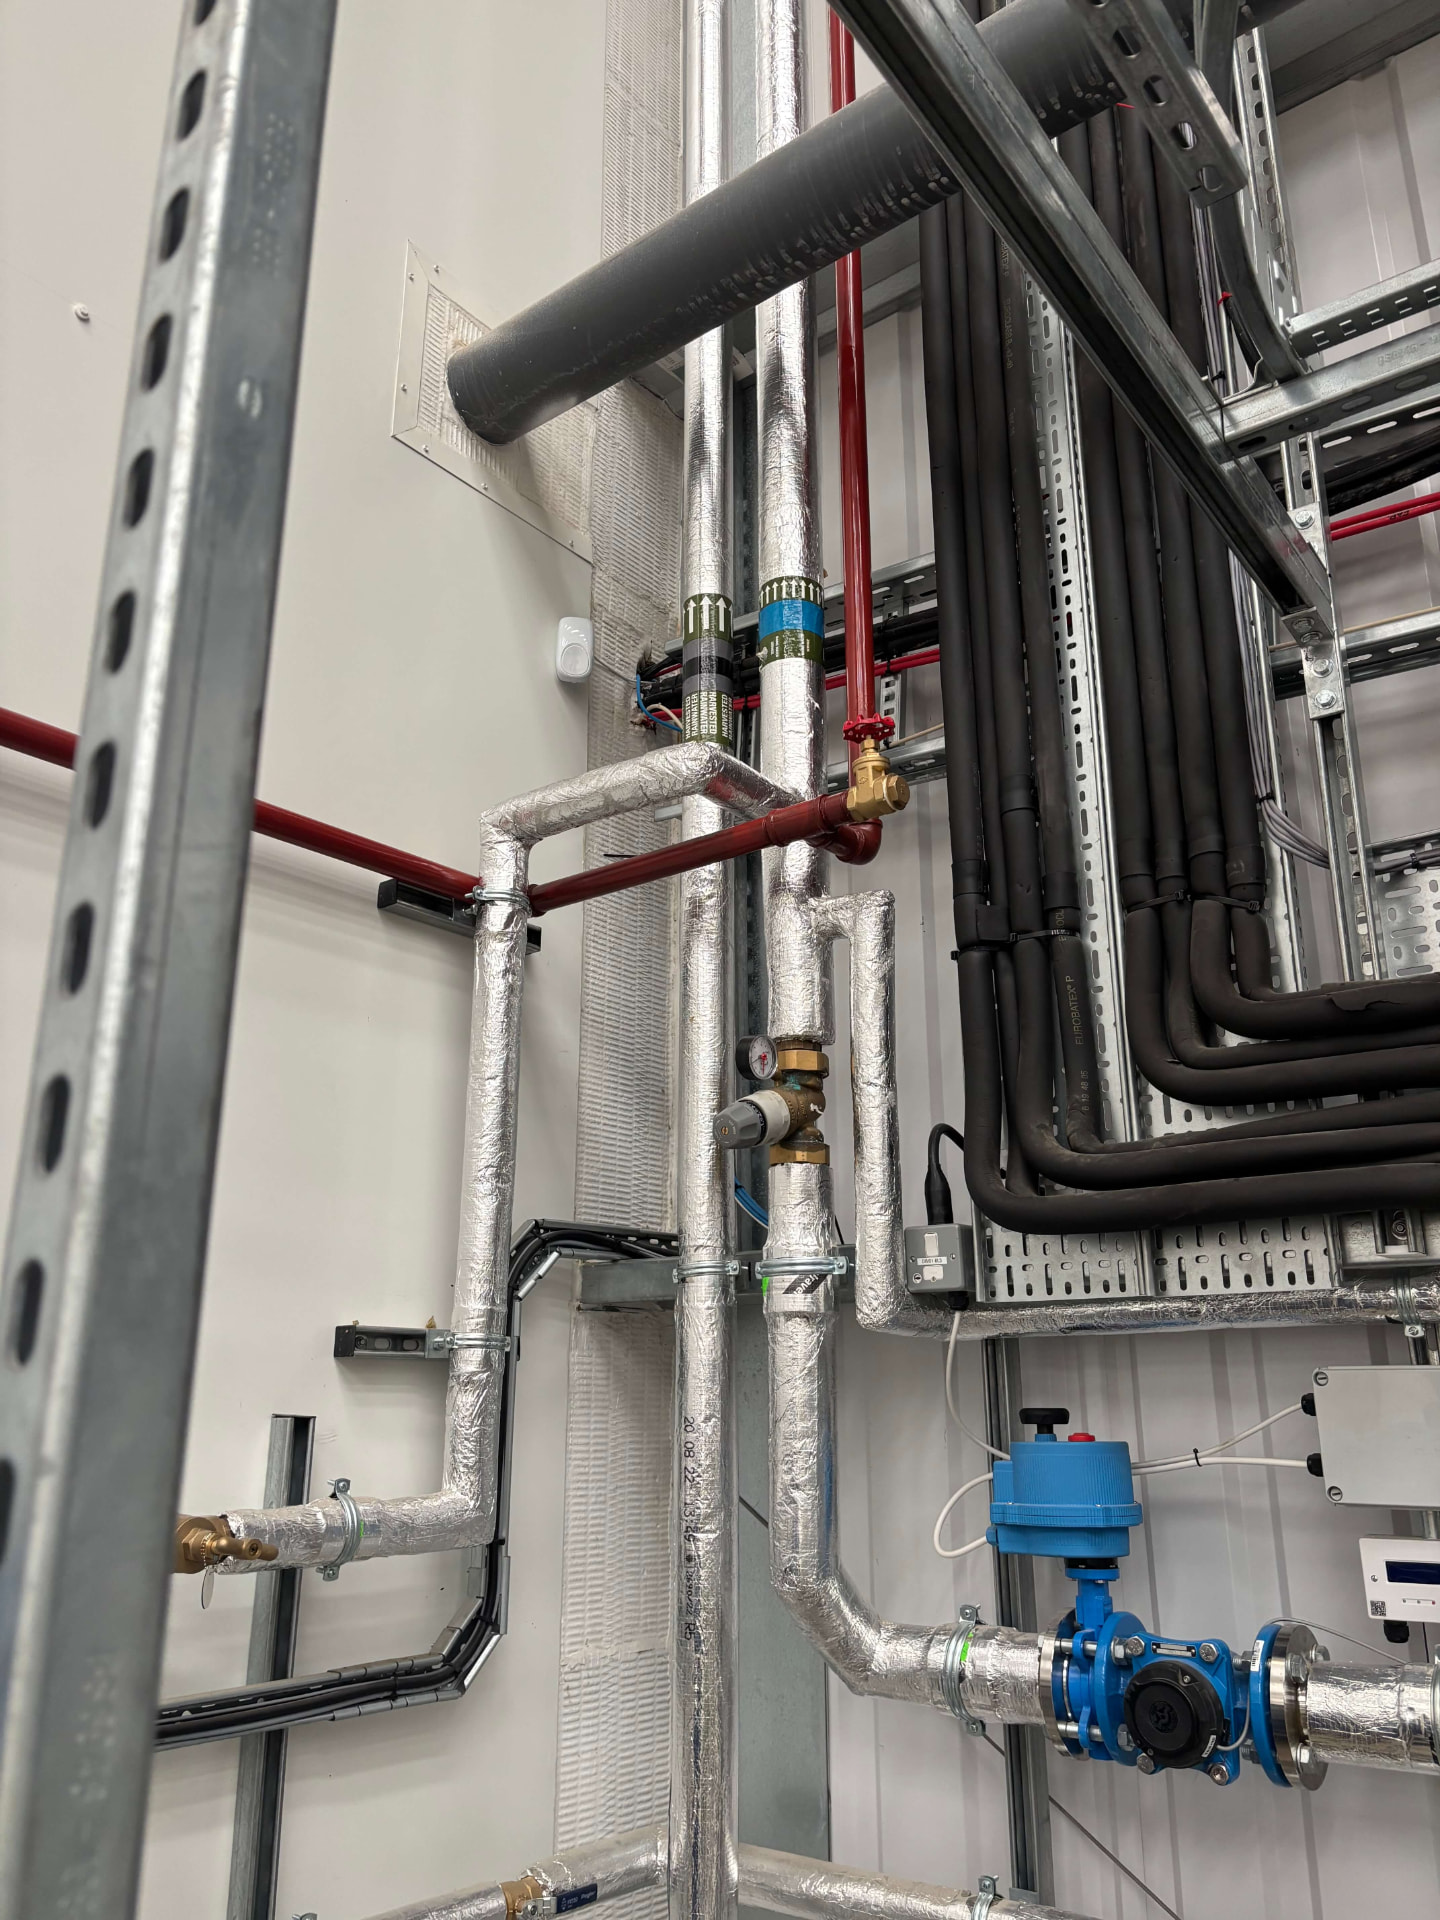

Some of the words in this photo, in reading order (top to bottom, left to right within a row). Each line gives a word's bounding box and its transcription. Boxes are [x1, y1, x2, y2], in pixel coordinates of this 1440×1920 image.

[691, 692, 699, 737] RAINWATER
[700, 691, 708, 735] RAINWATER
[709, 691, 718, 735] HARVESTED
[721, 694, 729, 738] HARVESTED
[1065, 975, 1075, 983] P
[683, 1416, 695, 1433] 20
[683, 1441, 696, 1458] 08
[683, 1466, 695, 1484] 22
[684, 1622, 696, 1641] R5
